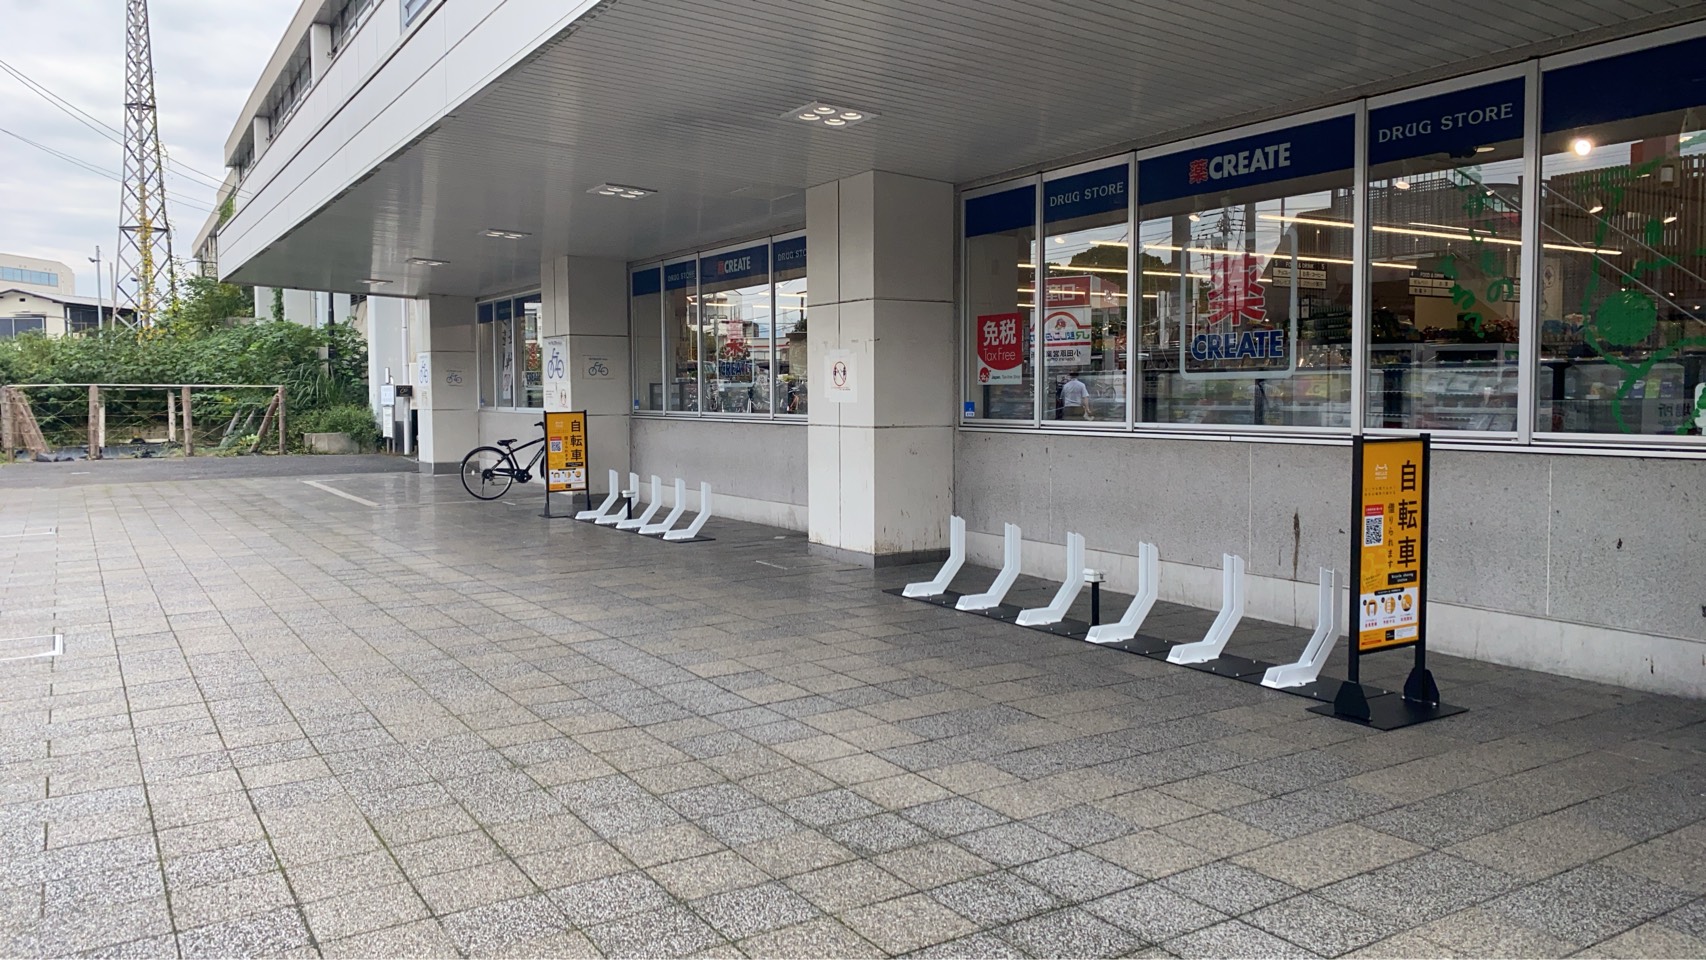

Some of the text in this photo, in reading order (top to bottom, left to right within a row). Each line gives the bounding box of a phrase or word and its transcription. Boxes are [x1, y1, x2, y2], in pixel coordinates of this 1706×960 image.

[1378, 103, 1513, 144] DRUG STORE
[1208, 141, 1291, 180] CREATE
[1050, 181, 1124, 207] DRUG STORE
[724, 256, 751, 274] CREATE
[796, 248, 807, 259] STO
[1207, 253, 1266, 327] 薬
[982, 318, 1017, 347] 免税
[1190, 330, 1285, 361] CREATE
[983, 347, 1016, 361] Tax Free
[570, 420, 583, 461] 自転車
[1397, 460, 1418, 568] 自転車
[1387, 503, 1395, 570] 借りられます
